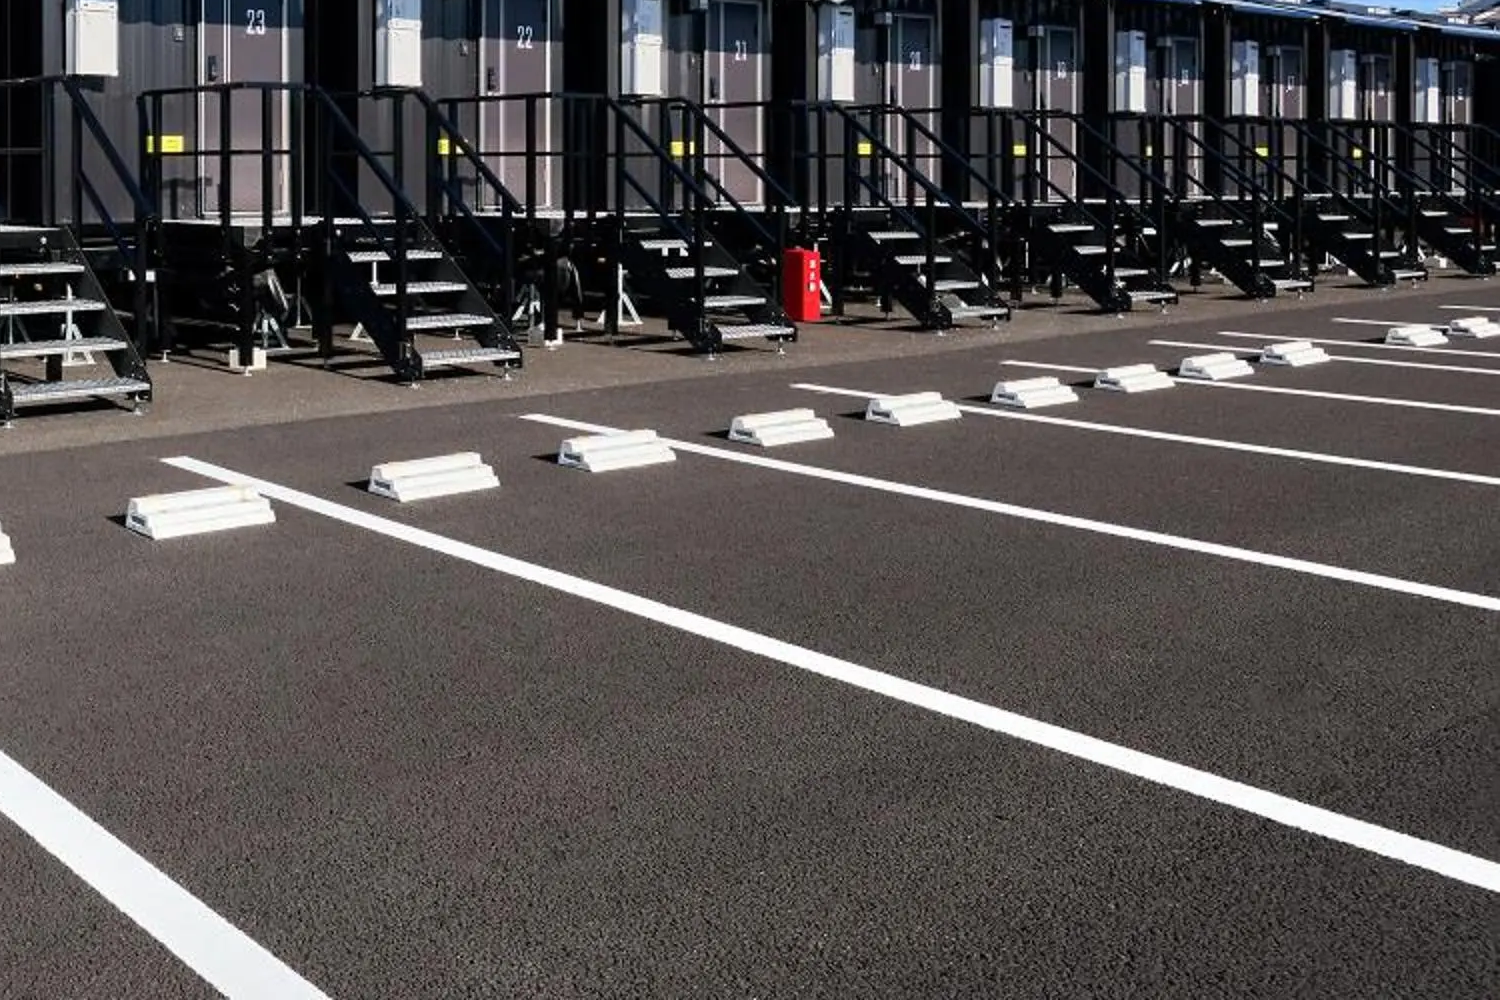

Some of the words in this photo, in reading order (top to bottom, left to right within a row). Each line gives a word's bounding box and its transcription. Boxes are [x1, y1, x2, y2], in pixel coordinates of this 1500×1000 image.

[246, 9, 266, 35] 23
[517, 25, 534, 49] 22
[735, 40, 747, 61] 21
